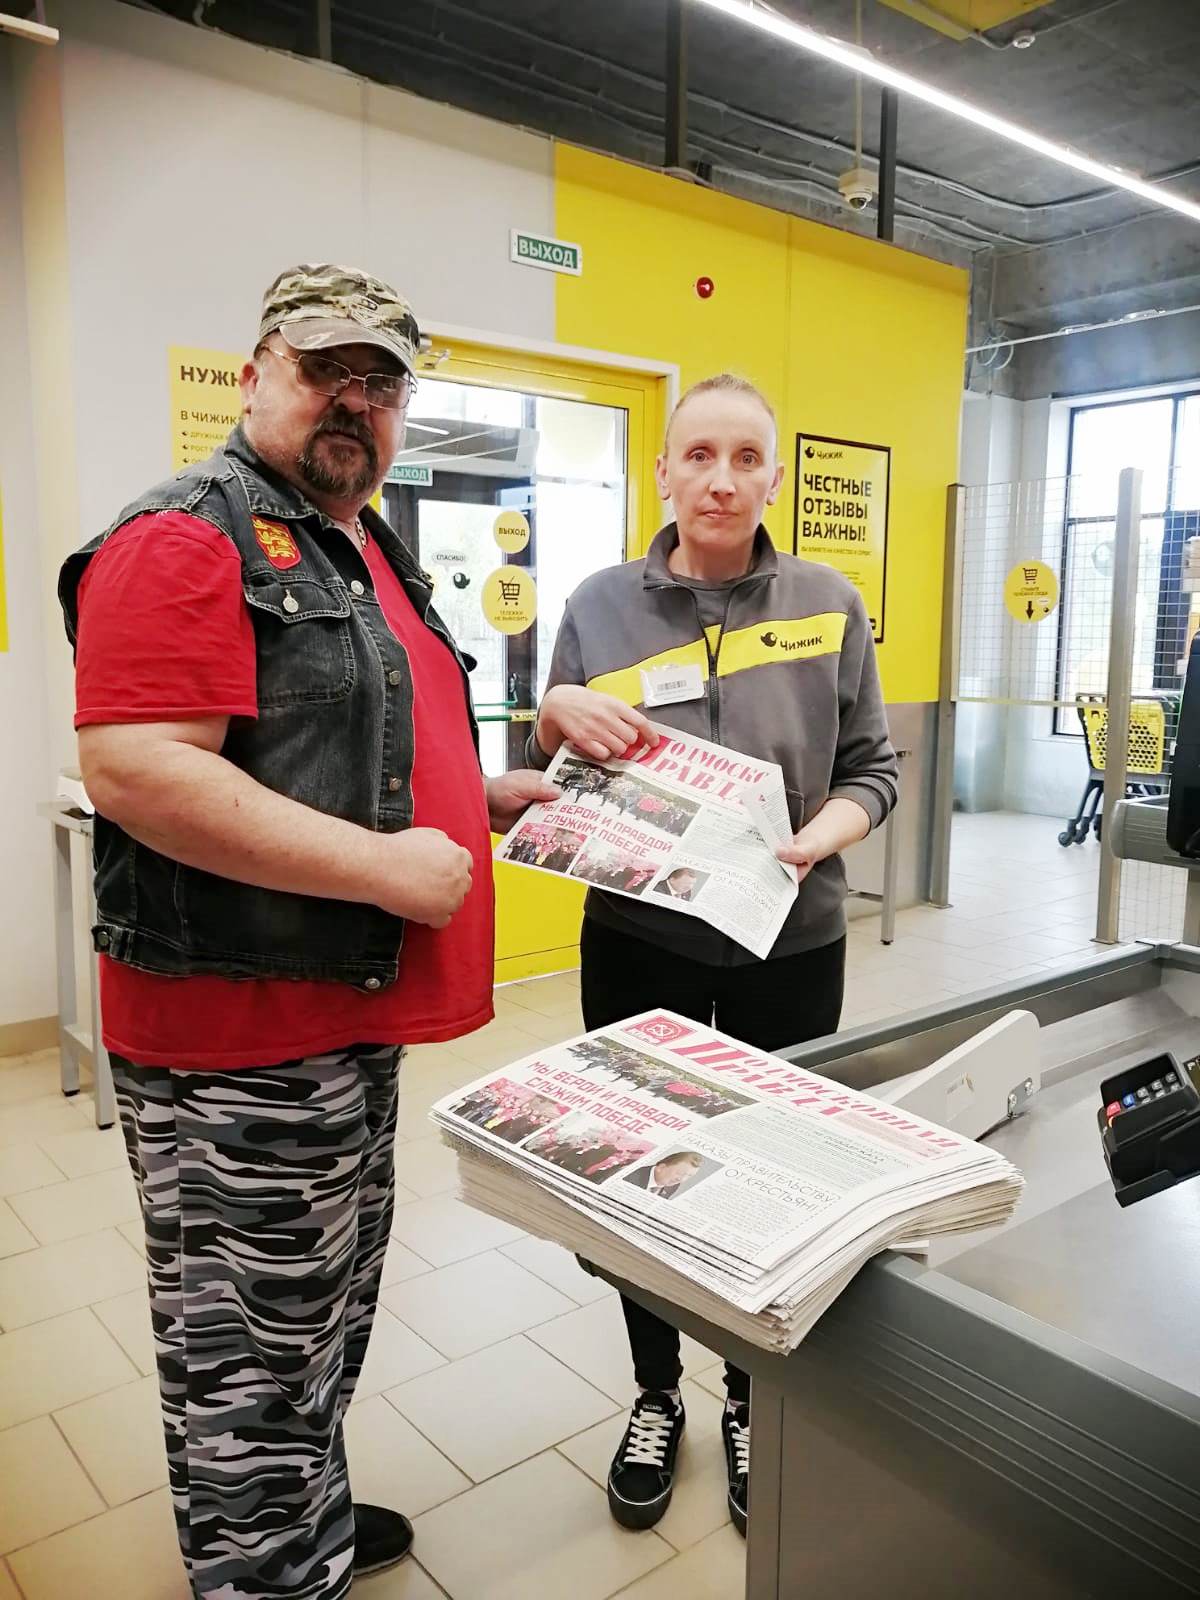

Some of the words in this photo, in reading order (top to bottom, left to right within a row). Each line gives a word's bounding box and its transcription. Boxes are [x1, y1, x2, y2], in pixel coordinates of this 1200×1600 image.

[519, 239, 574, 268] ВЫХОД
[181, 410, 188, 420] В
[803, 473, 872, 497] ЧЕСТНЫЕ
[803, 497, 868, 520] ОТЗЫВЫ
[498, 527, 526, 537] ВЫХОД
[802, 520, 866, 542] ВАЖНЫ!
[779, 635, 823, 651] Чижик
[543, 814, 597, 835] СЛУЖИМ
[599, 828, 652, 857] ПОБЕДЕ
[560, 804, 600, 821] ВЕРОЙ
[601, 817, 612, 826] И
[612, 821, 673, 853] ПРАВДОЙ
[525, 1077, 590, 1108] СЛУЖИМ
[588, 1103, 653, 1134] ПОБЕДЕ
[528, 1061, 556, 1075] МЫ
[553, 1070, 606, 1095] ВЕРОЙ
[604, 1091, 619, 1101] И
[617, 1096, 691, 1131] ПРАВДОЙ
[687, 1135, 731, 1160] НАКАЗЫ
[730, 1152, 840, 1202] ПРАВИТЕЛЬСТВУ
[725, 1168, 747, 1180] ОТ
